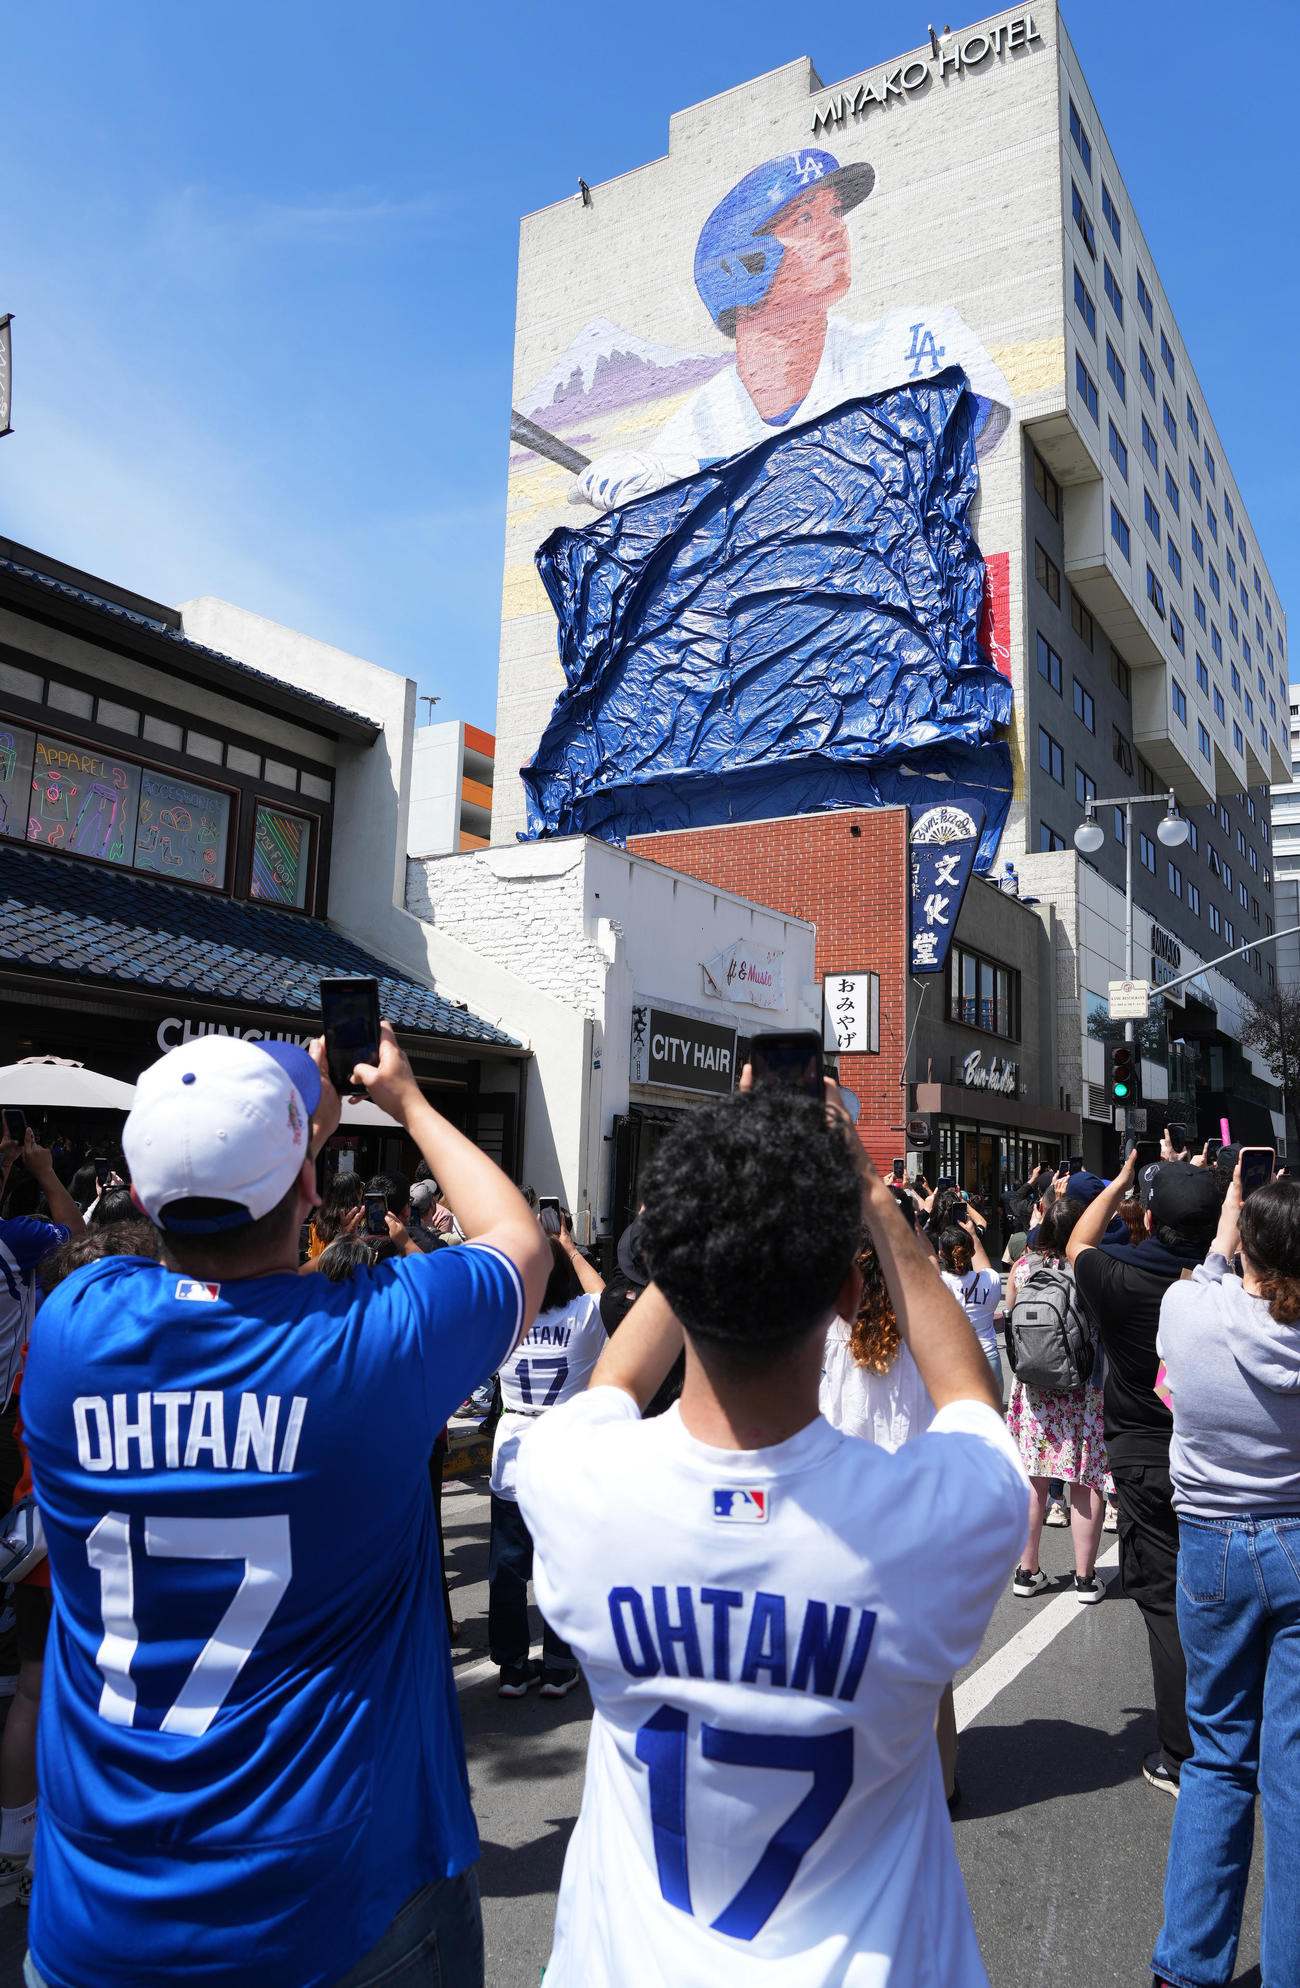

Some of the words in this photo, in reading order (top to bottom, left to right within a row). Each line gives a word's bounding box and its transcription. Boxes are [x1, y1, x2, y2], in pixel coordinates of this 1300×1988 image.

[811, 60, 929, 132] MIYAKO
[939, 14, 1041, 78] HOTEL
[904, 323, 946, 378] LA
[35, 742, 109, 779] APPAREL
[256, 826, 275, 852] 2nd
[271, 851, 294, 886] Floor
[912, 854, 961, 964] 文化堂
[748, 963, 772, 987] Music
[836, 978, 857, 1049] おみやげ
[652, 1033, 692, 1065] CITY
[693, 1042, 731, 1073] HAIR
[515, 1356, 569, 1407] 17
[73, 1390, 308, 1474] OHTANI
[86, 1511, 293, 1738] 17
[607, 1584, 878, 1702] OHTANI
[635, 1703, 855, 1942] 17
